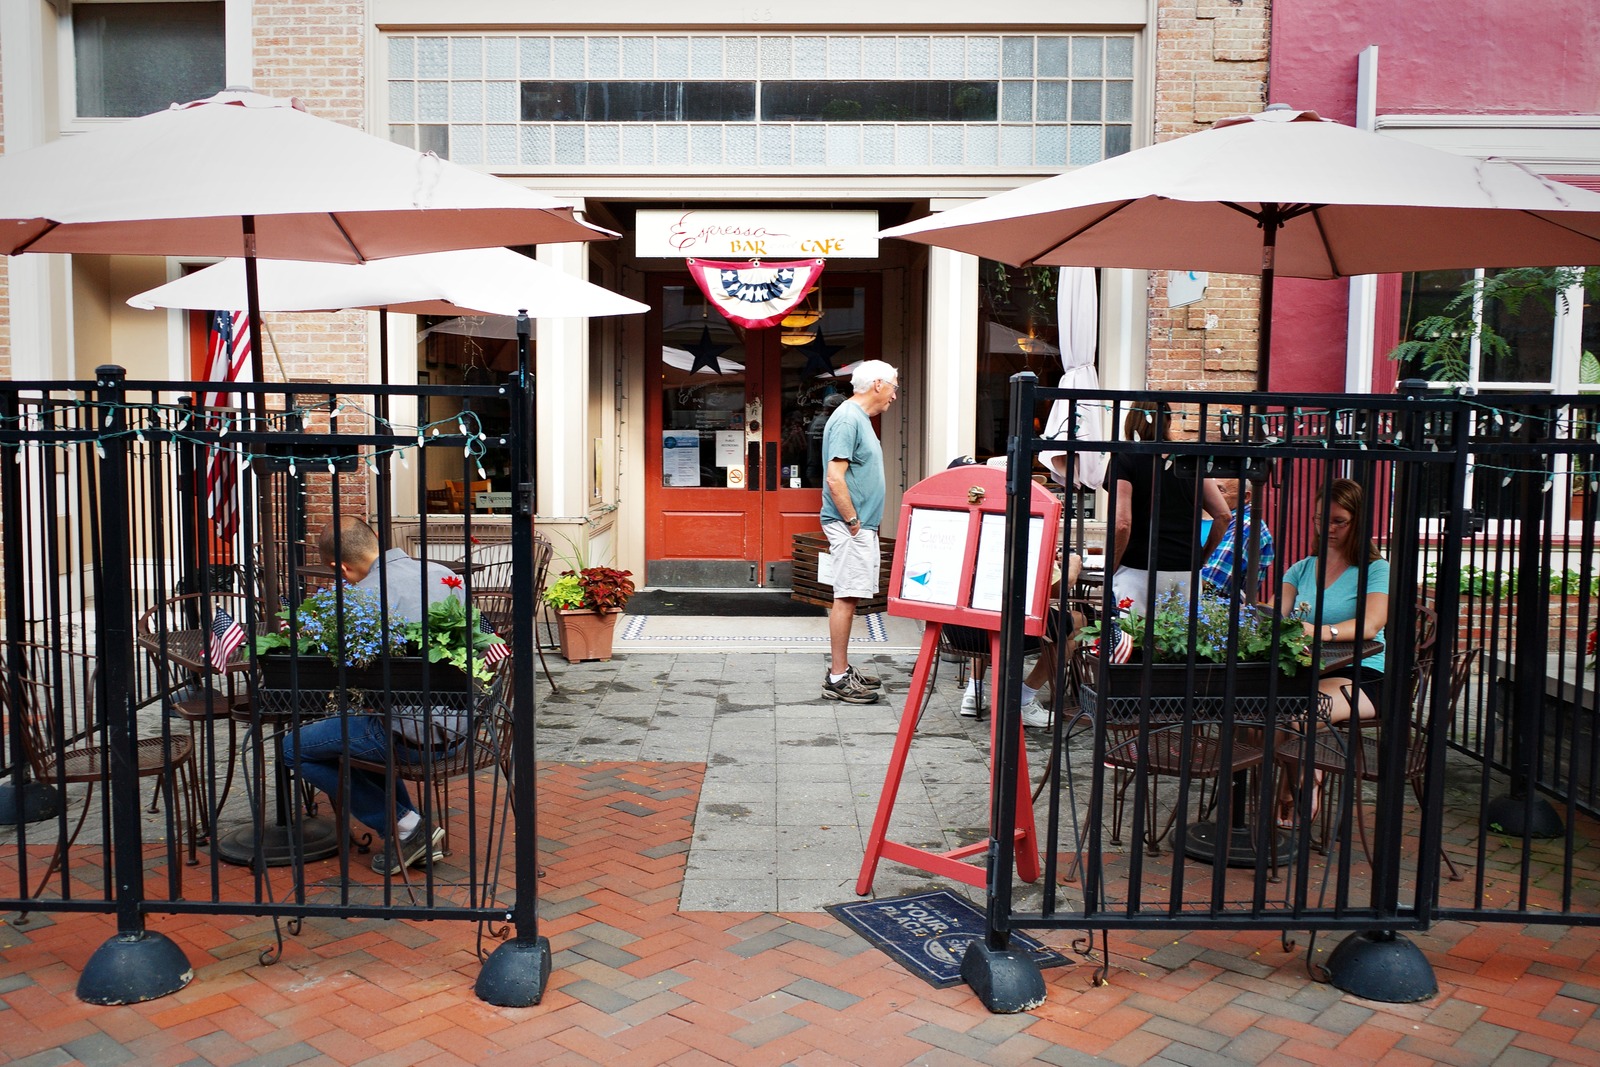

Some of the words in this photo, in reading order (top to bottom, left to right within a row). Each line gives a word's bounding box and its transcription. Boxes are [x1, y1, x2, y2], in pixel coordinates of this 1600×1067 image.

[669, 210, 791, 252] Espresso
[731, 240, 767, 255] BAR
[801, 238, 845, 255] CAFE
[877, 906, 931, 936] PLACE
[899, 903, 949, 931] YOUR
